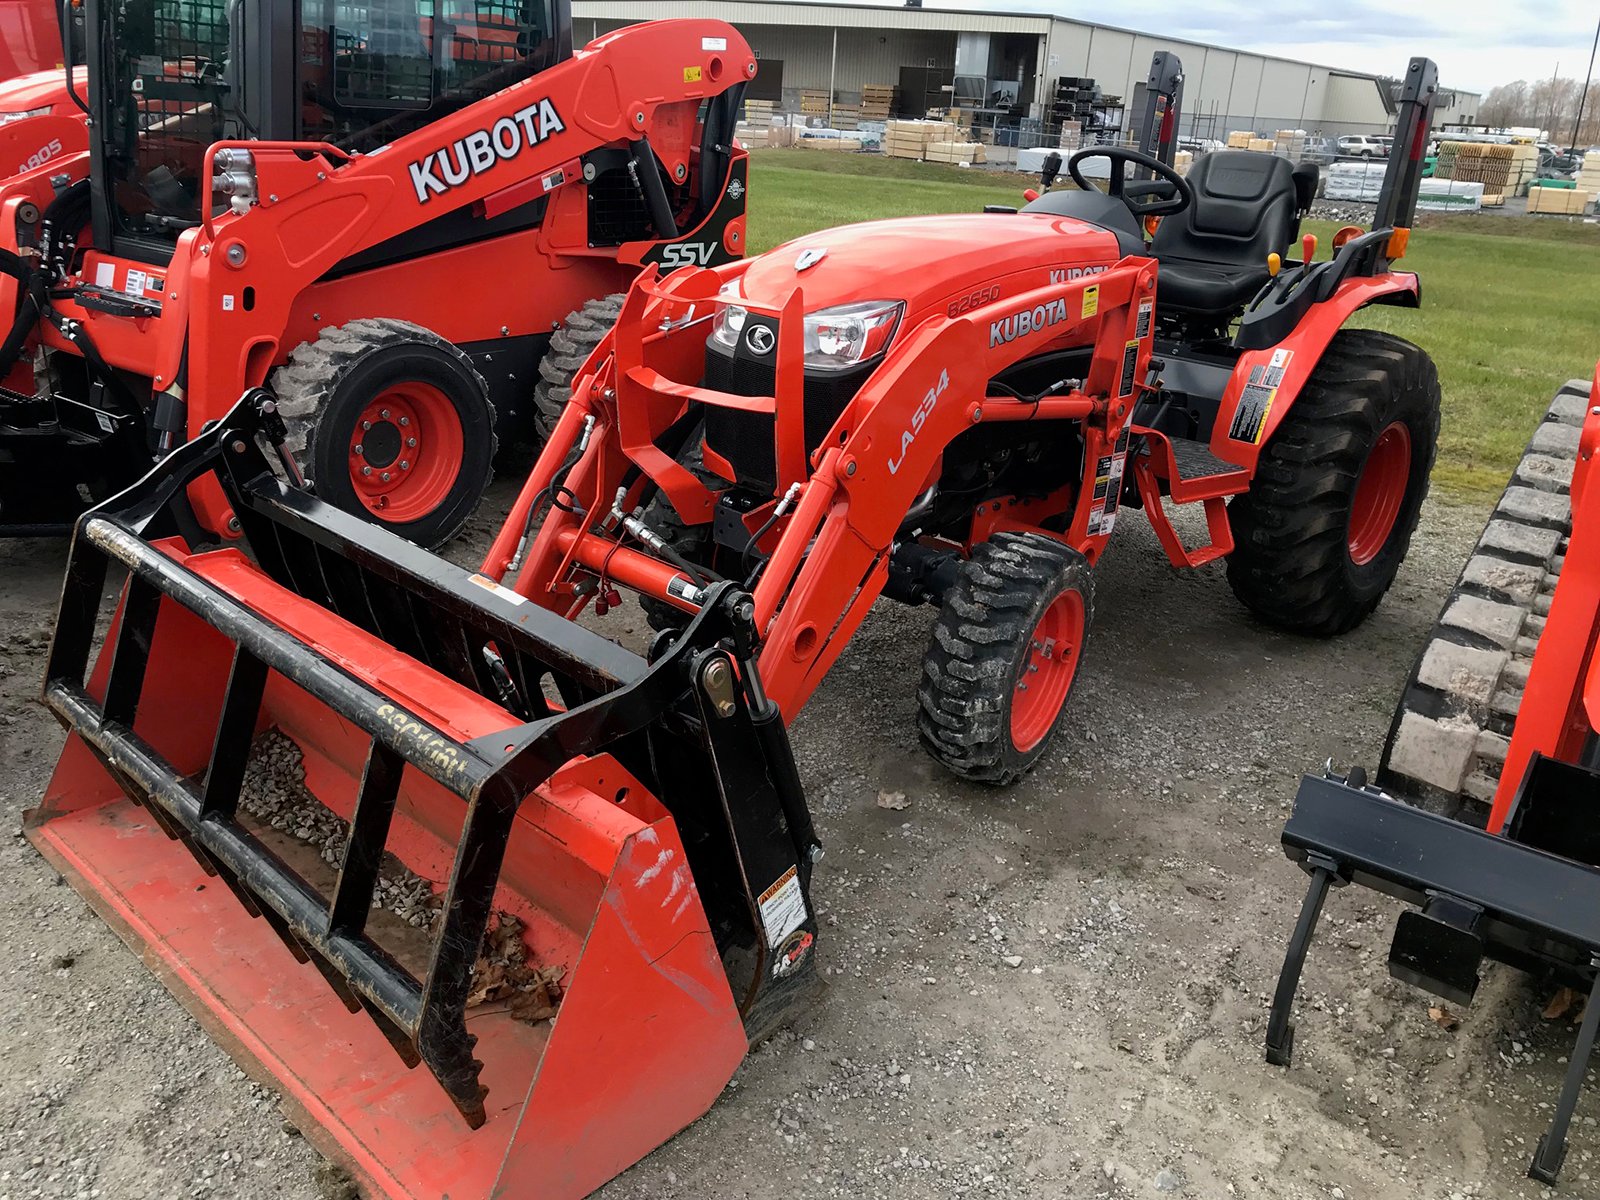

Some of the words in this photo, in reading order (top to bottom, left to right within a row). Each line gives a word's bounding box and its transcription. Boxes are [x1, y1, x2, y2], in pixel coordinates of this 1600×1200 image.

[408, 97, 567, 204] KUBOTA
[659, 241, 718, 268] SSV
[947, 284, 1000, 318] B2650
[989, 297, 1068, 348] KUBOTA
[887, 367, 950, 475] LA534
[766, 867, 797, 898] WARNING
